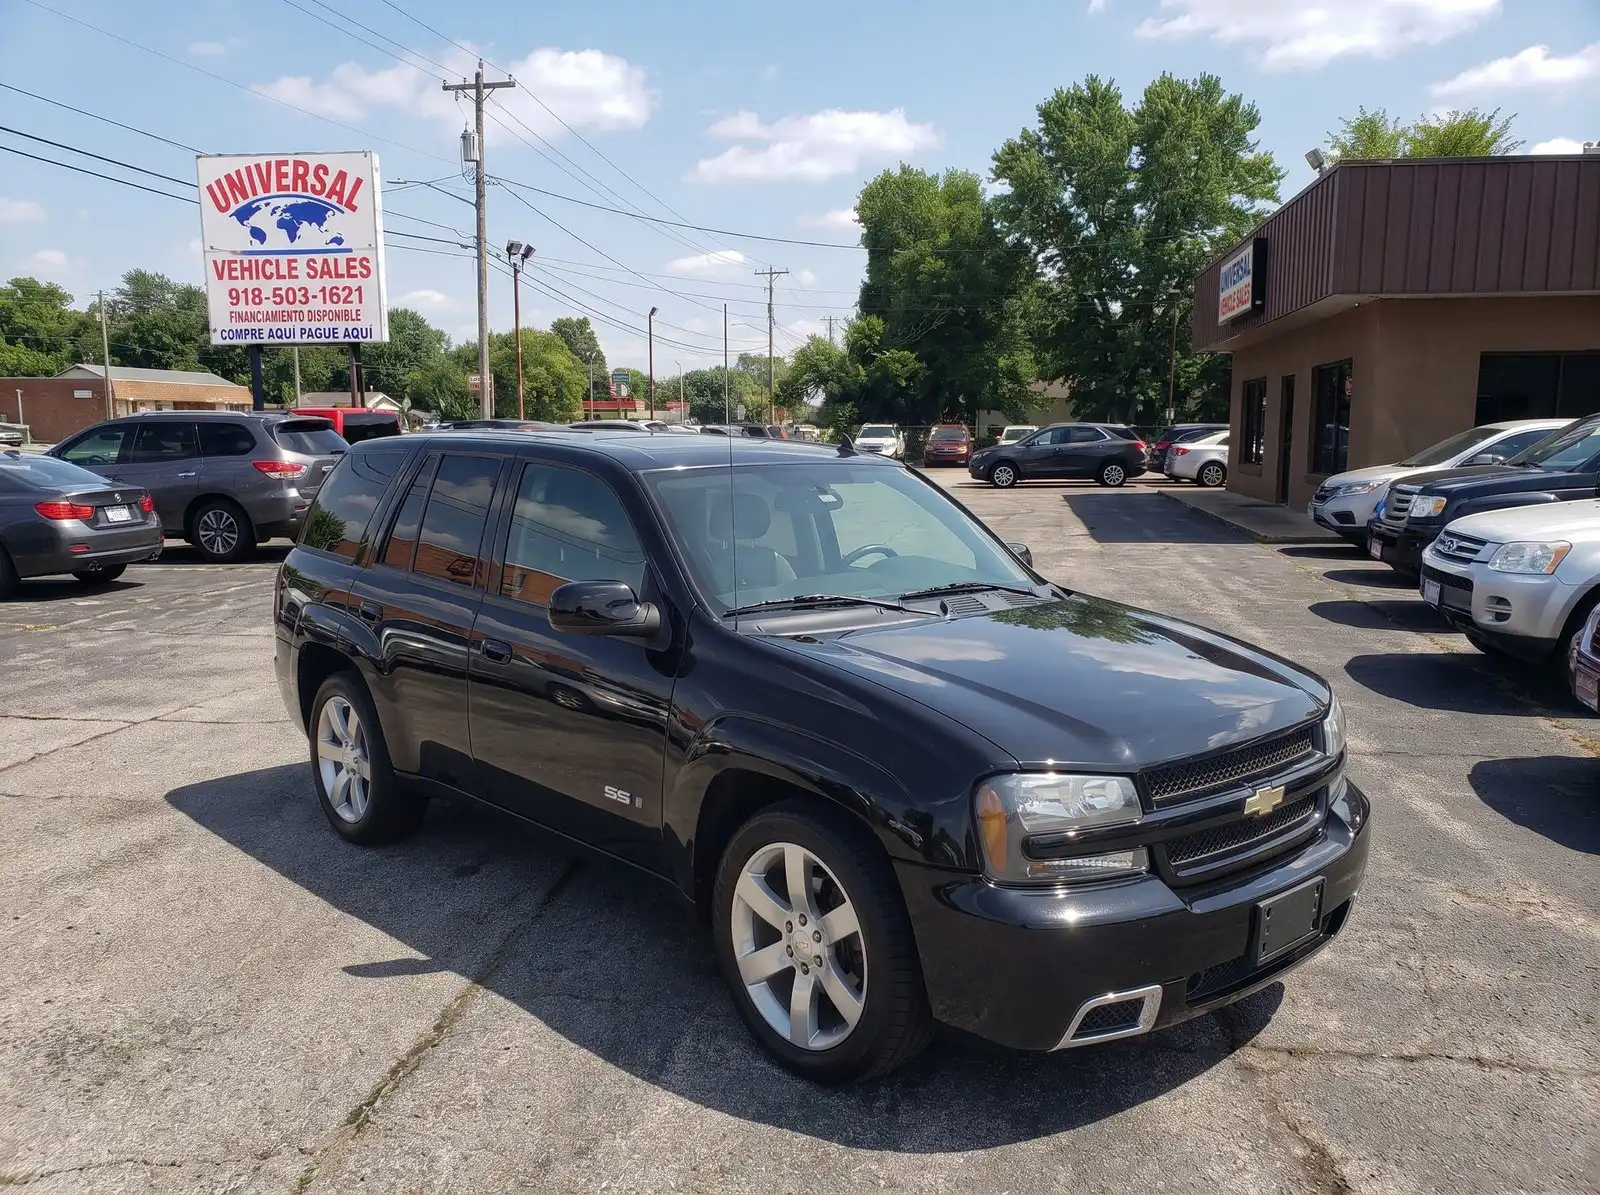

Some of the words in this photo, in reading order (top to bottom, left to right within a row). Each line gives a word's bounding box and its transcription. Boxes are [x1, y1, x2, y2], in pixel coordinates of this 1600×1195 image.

[205, 159, 364, 214] UNIVERSAL
[212, 258, 299, 281] VEHICLE
[306, 257, 372, 279] SALES
[228, 285, 364, 306] 918-503-1621
[229, 309, 305, 323] FINANCIAMIENTO
[307, 309, 362, 322] DISPONIBLE
[220, 327, 265, 340] COMPRE
[267, 325, 296, 339] AQUÍ
[299, 327, 339, 340] PAGUE
[343, 324, 373, 339] AQUÍ
[604, 785, 631, 805] SS
